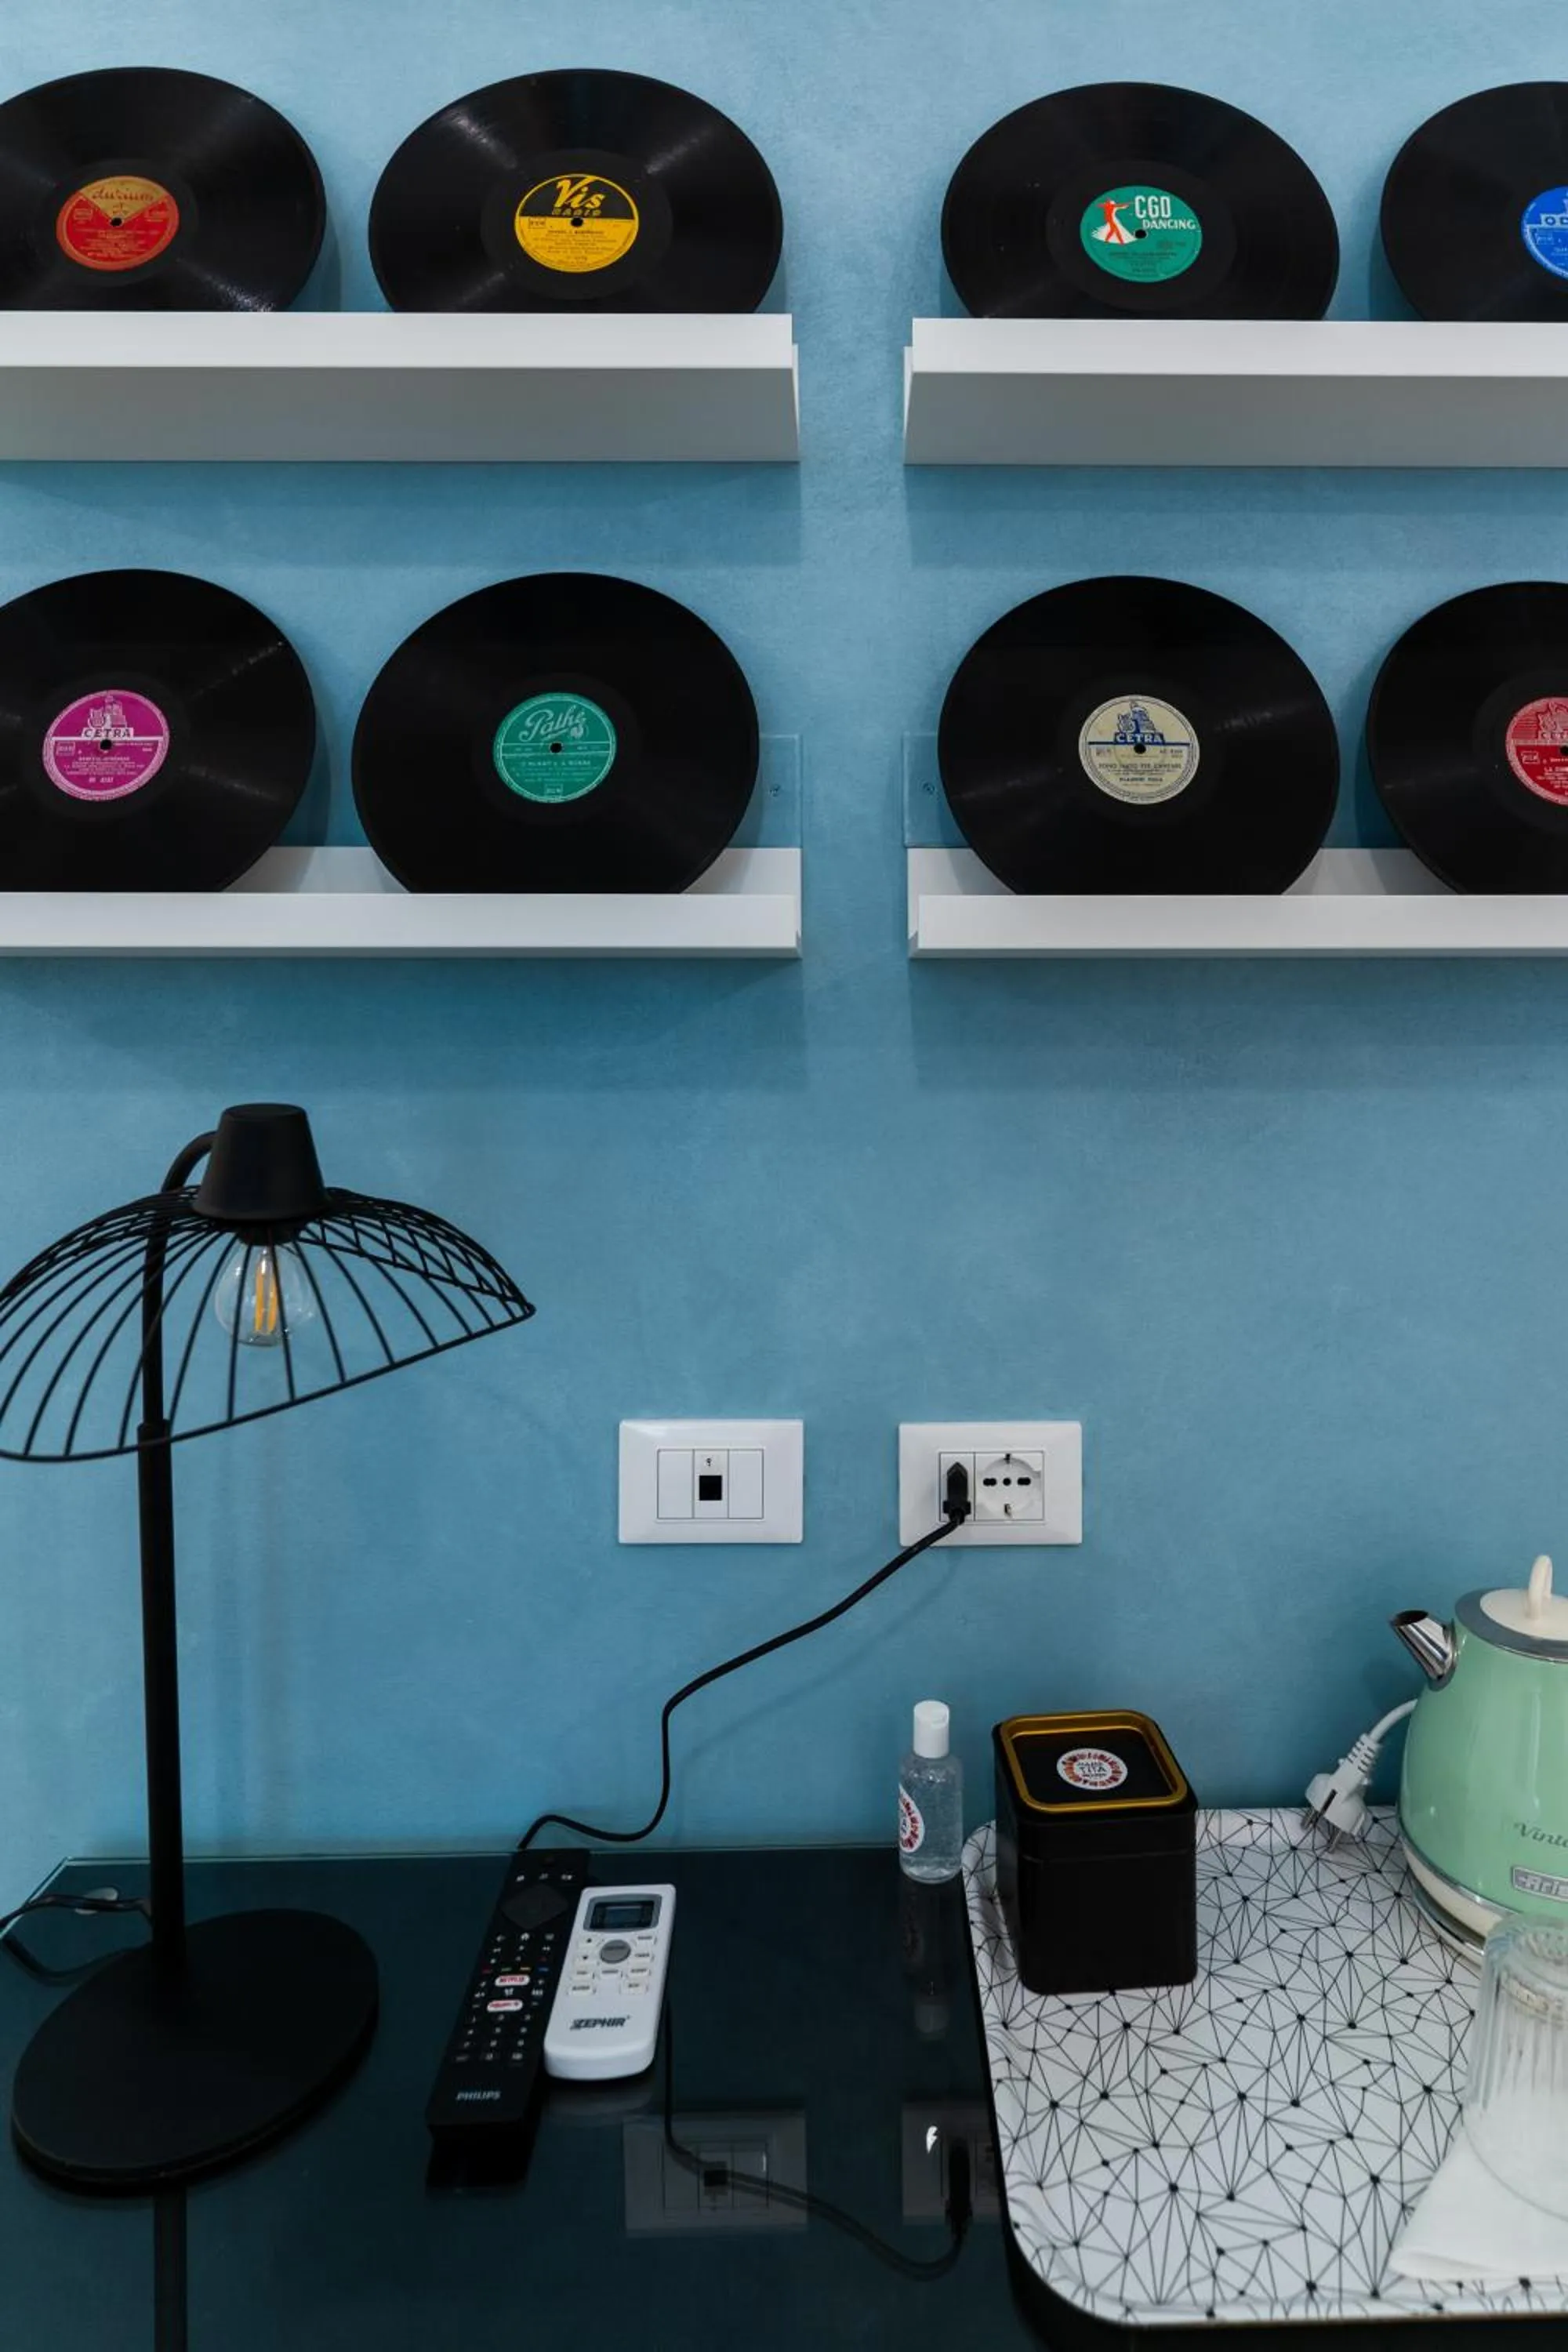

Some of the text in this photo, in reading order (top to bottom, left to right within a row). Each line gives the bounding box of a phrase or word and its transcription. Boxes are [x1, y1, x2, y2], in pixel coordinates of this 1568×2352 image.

[556, 176, 605, 209] Vis
[1134, 196, 1171, 219] CGD
[1142, 220, 1196, 230] DANCING
[83, 729, 131, 739] CETRA
[1116, 734, 1163, 743] CETRA
[570, 2016, 627, 2030] ZEPHIR
[456, 2090, 502, 2101] PHILIPS
